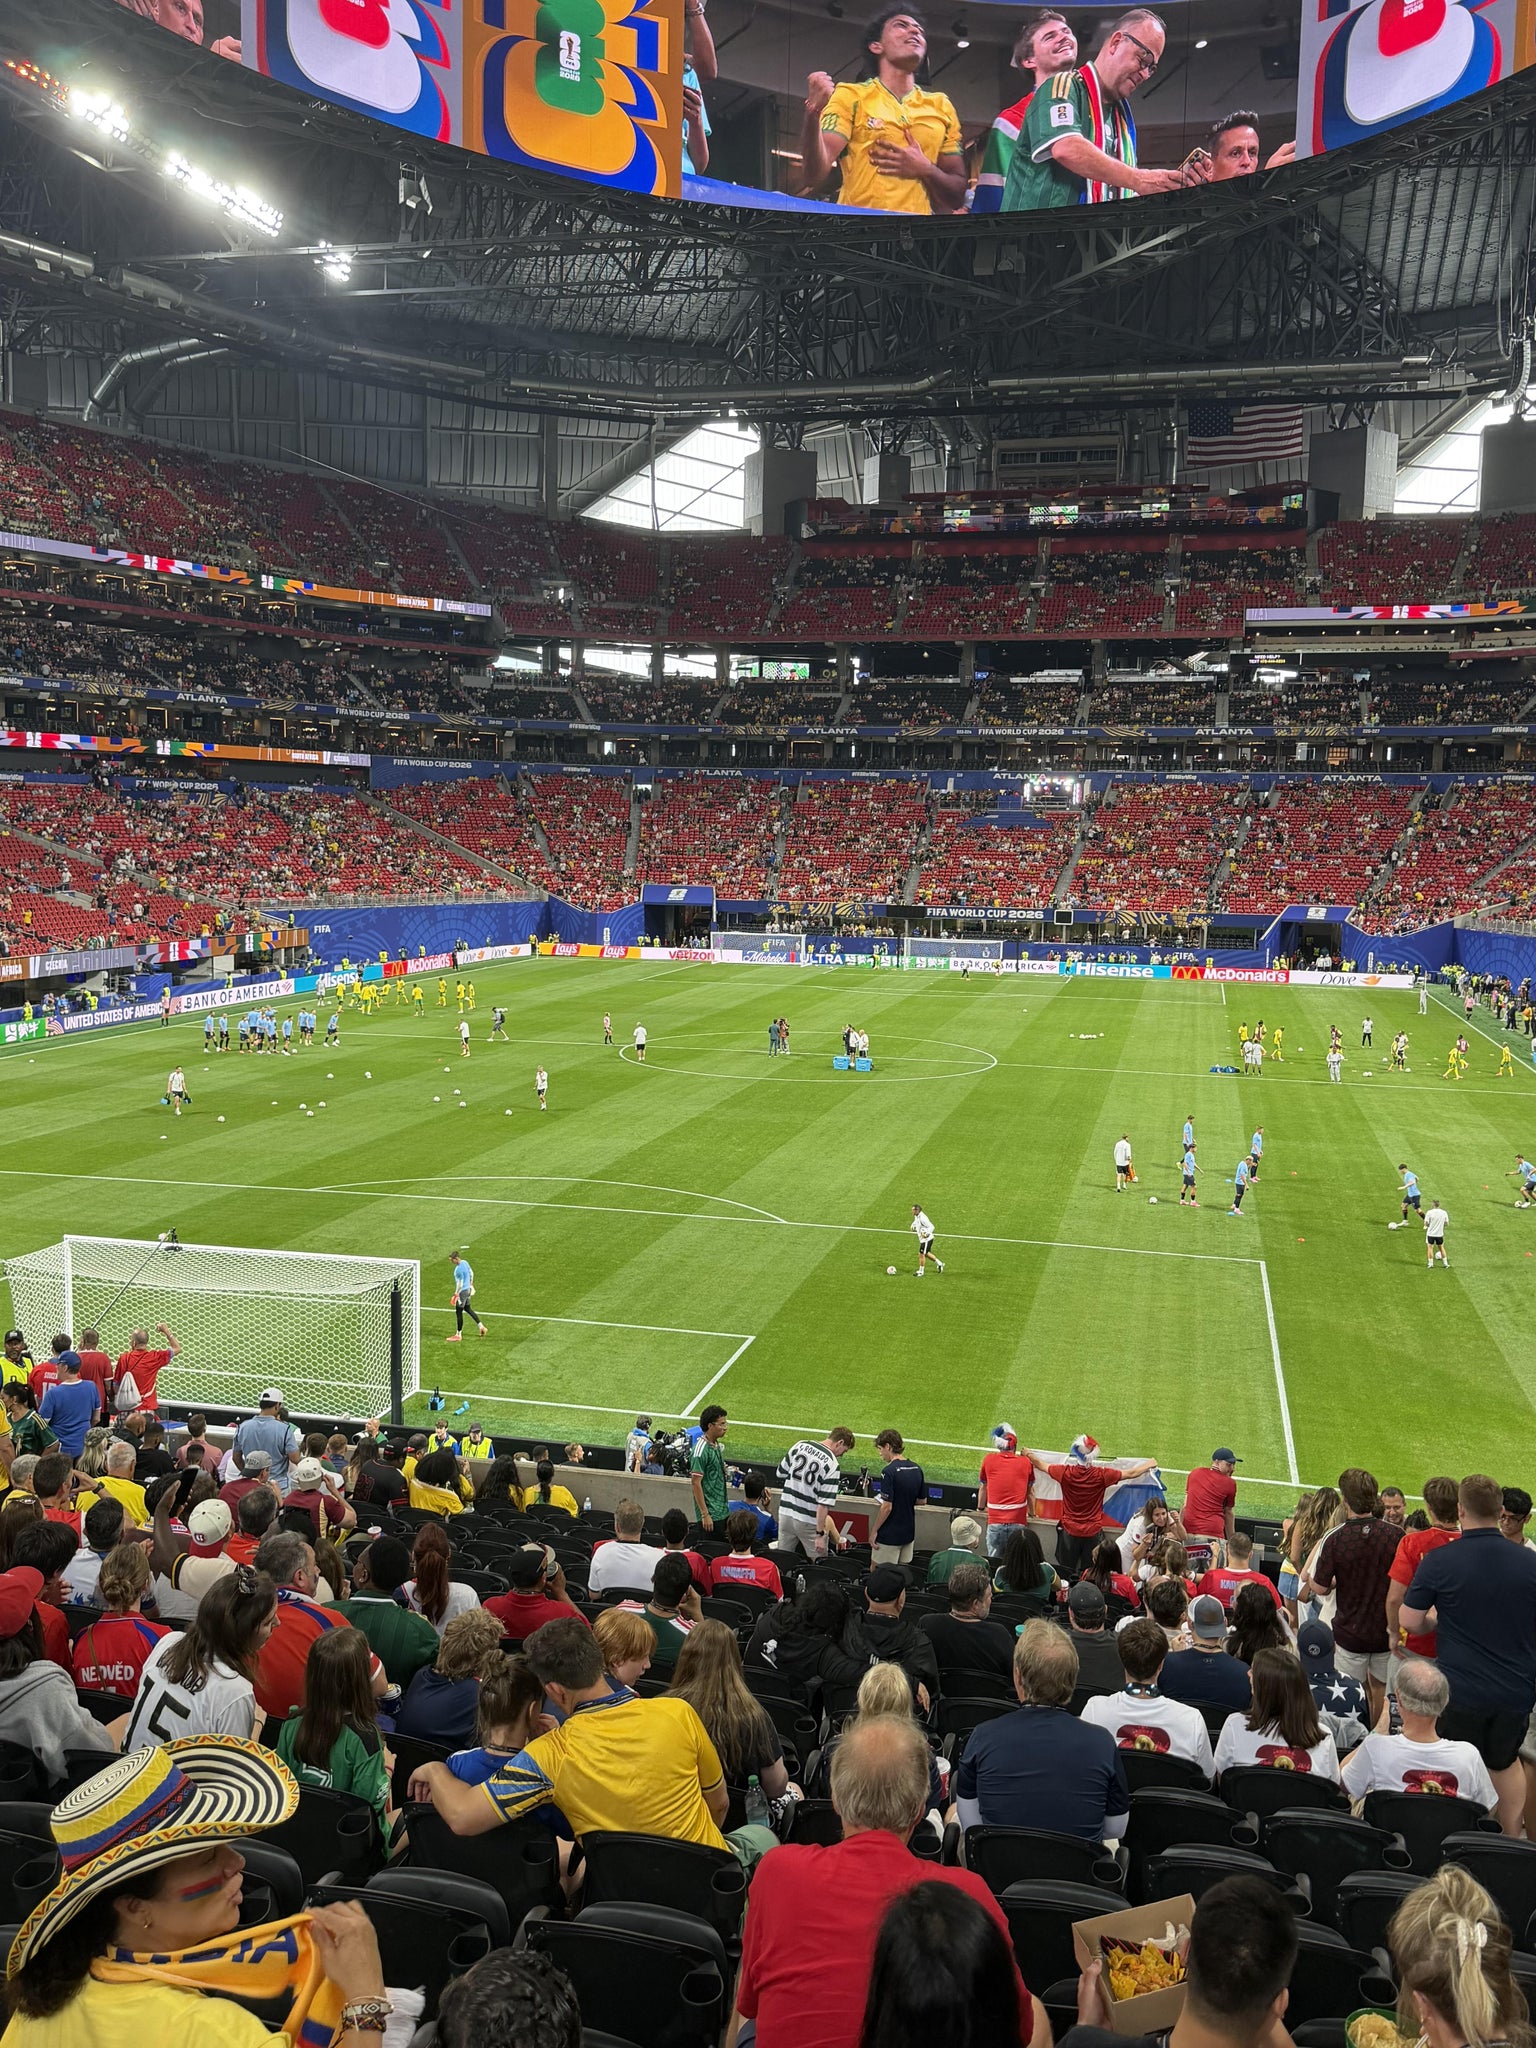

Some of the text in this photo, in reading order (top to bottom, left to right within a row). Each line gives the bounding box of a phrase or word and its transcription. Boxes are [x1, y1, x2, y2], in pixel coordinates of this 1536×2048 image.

[176, 692, 228, 704] ATLANTA
[349, 709, 369, 717] WORLD
[806, 727, 858, 735] ATLANTA
[1322, 774, 1382, 782] ATLANTA
[927, 908, 1044, 919] FIFA WORLD CUP 2026
[314, 925, 331, 933] FIFA
[767, 939, 785, 947] FIFA
[556, 944, 578, 956] Lay's
[603, 946, 626, 958] Lay's
[668, 948, 715, 961] verizon
[407, 953, 451, 973] McDonald's
[800, 953, 843, 965] ULTRA
[2, 964, 23, 976] AFRICA
[1076, 962, 1154, 977] Hisense
[1203, 967, 1287, 982] McDonald's
[316, 971, 358, 988] Hisens
[1319, 972, 1357, 985] Dove
[186, 983, 281, 1009] BANK OF AMERICA
[64, 1001, 162, 1030] UNITED STATES OF AMERIC
[804, 1445, 830, 1464] RONALDO
[791, 1454, 820, 1486] 28
[81, 1661, 135, 1683] NEDVĚD
[121, 1674, 191, 1755] 15
